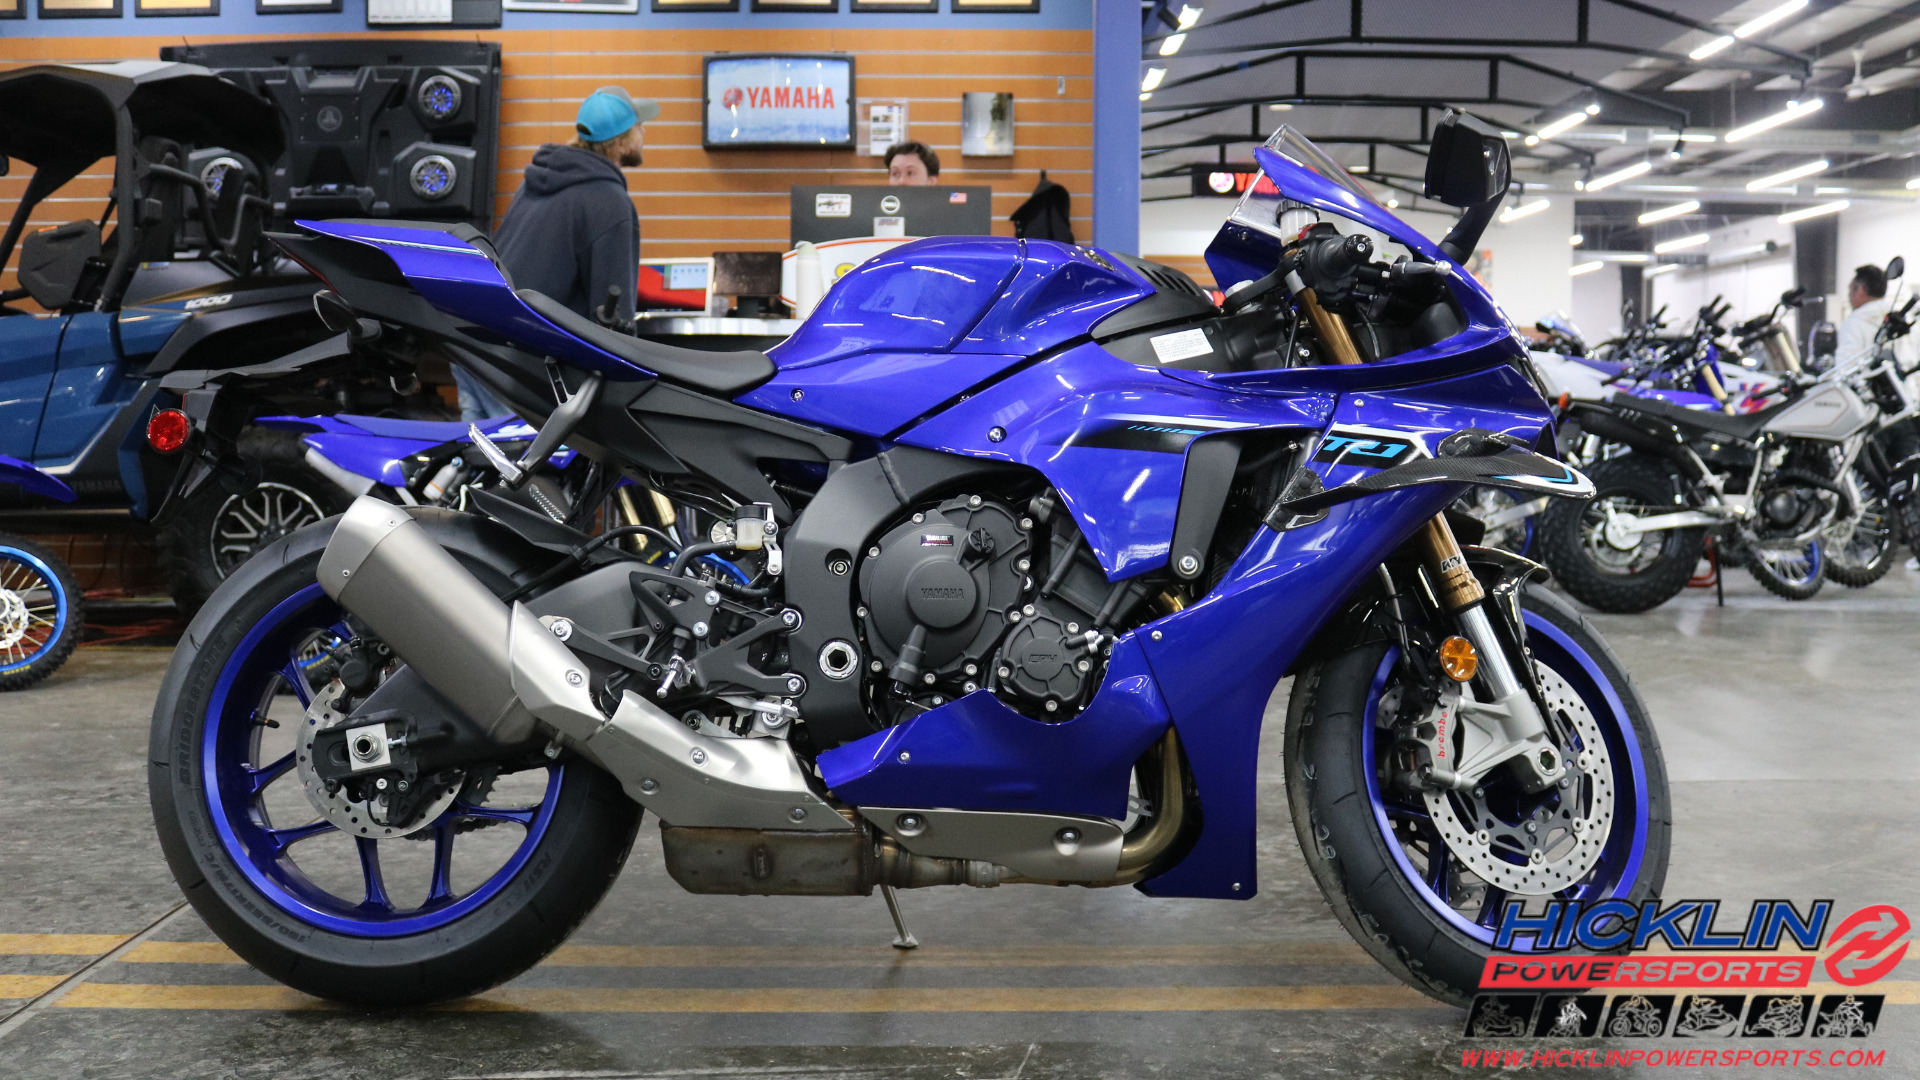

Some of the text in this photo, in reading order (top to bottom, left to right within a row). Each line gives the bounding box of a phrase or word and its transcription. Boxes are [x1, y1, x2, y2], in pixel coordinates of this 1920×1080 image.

[747, 86, 835, 109] YAMAHA
[184, 293, 233, 310] 1000
[921, 588, 964, 599] YAMAHA
[1437, 711, 1448, 758] brembo
